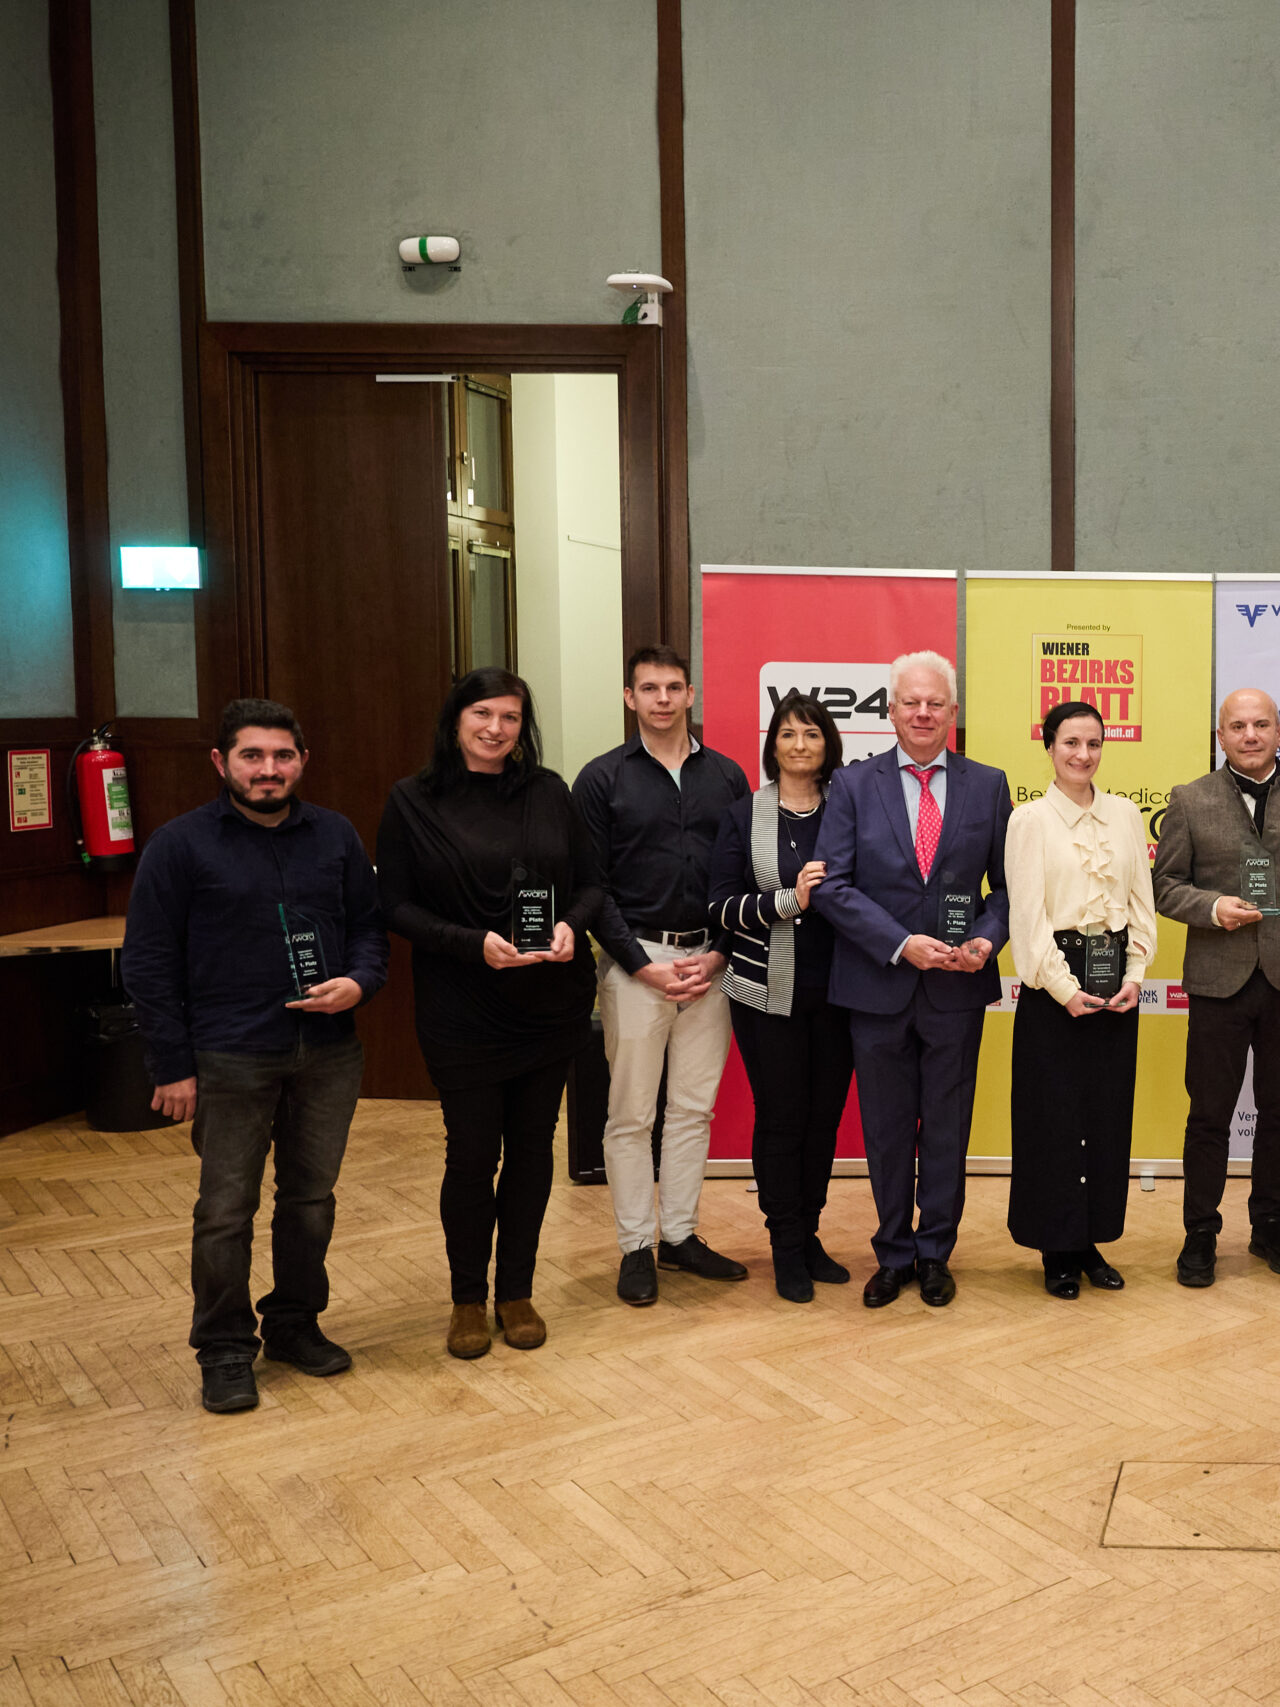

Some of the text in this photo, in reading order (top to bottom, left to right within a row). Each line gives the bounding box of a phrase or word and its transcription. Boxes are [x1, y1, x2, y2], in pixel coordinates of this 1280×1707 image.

[1102, 624, 1111, 632] by
[1042, 642, 1090, 656] WIENER
[1040, 658, 1135, 684] BEZIRKS
